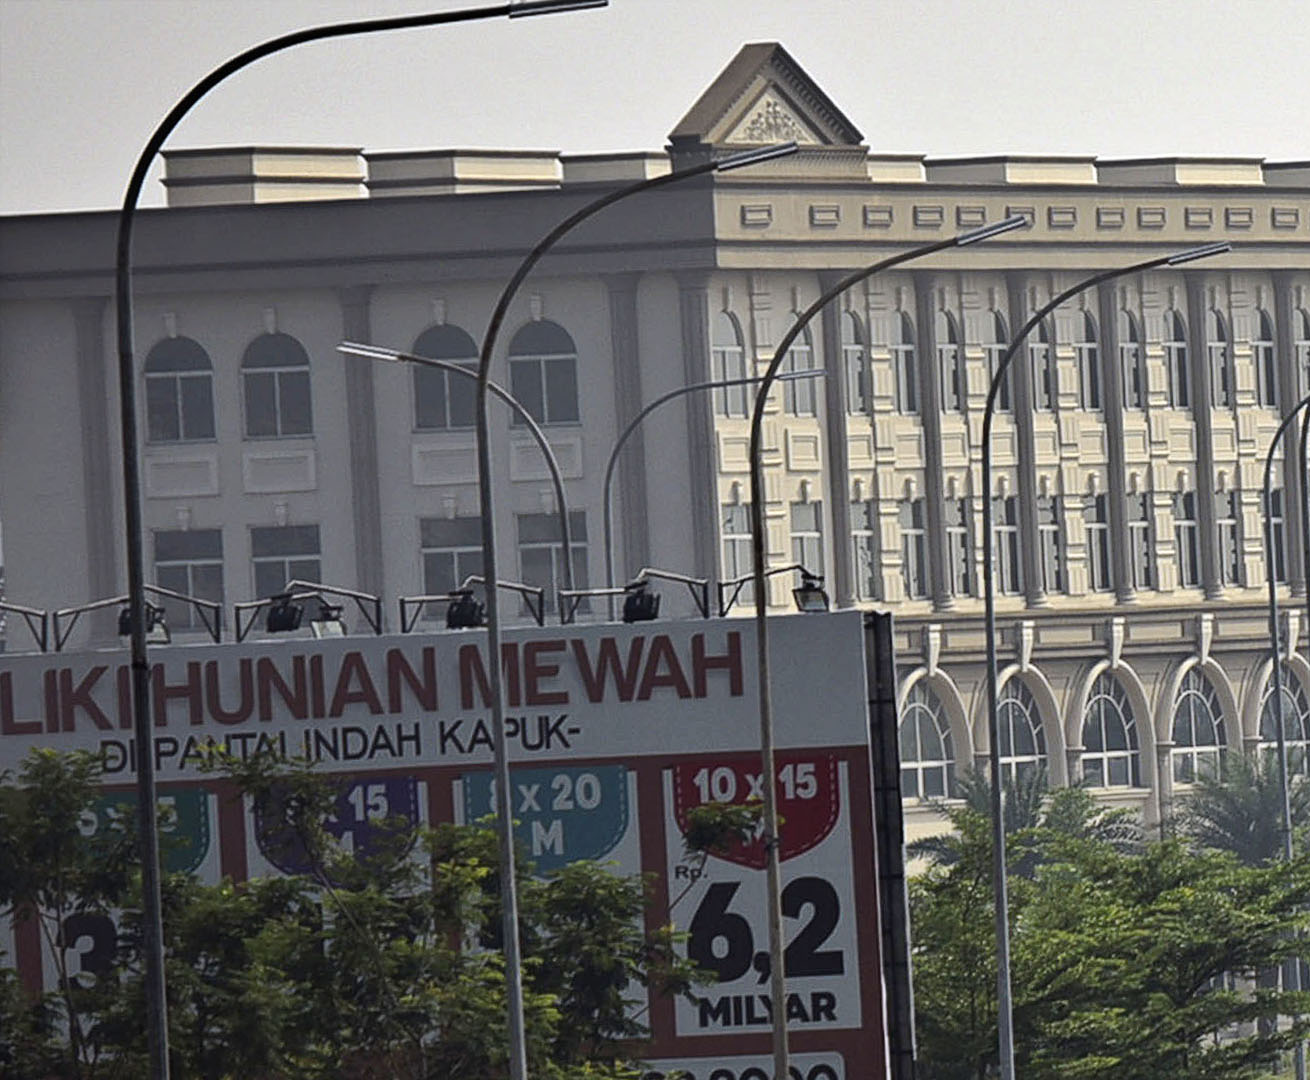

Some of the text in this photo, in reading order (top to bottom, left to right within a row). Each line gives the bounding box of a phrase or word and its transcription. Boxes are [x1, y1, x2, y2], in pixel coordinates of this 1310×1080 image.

[152, 646, 438, 727] HUNIAN
[459, 631, 744, 710] MEWAH
[154, 730, 288, 772] PANTAI
[303, 722, 422, 764] INDAH
[348, 783, 388, 822] 15
[551, 773, 600, 812] 20
[693, 766, 737, 803] 10
[778, 762, 819, 800] 15
[531, 819, 565, 857] M
[687, 876, 845, 986] 6,2
[698, 991, 838, 1028] MILYAR
